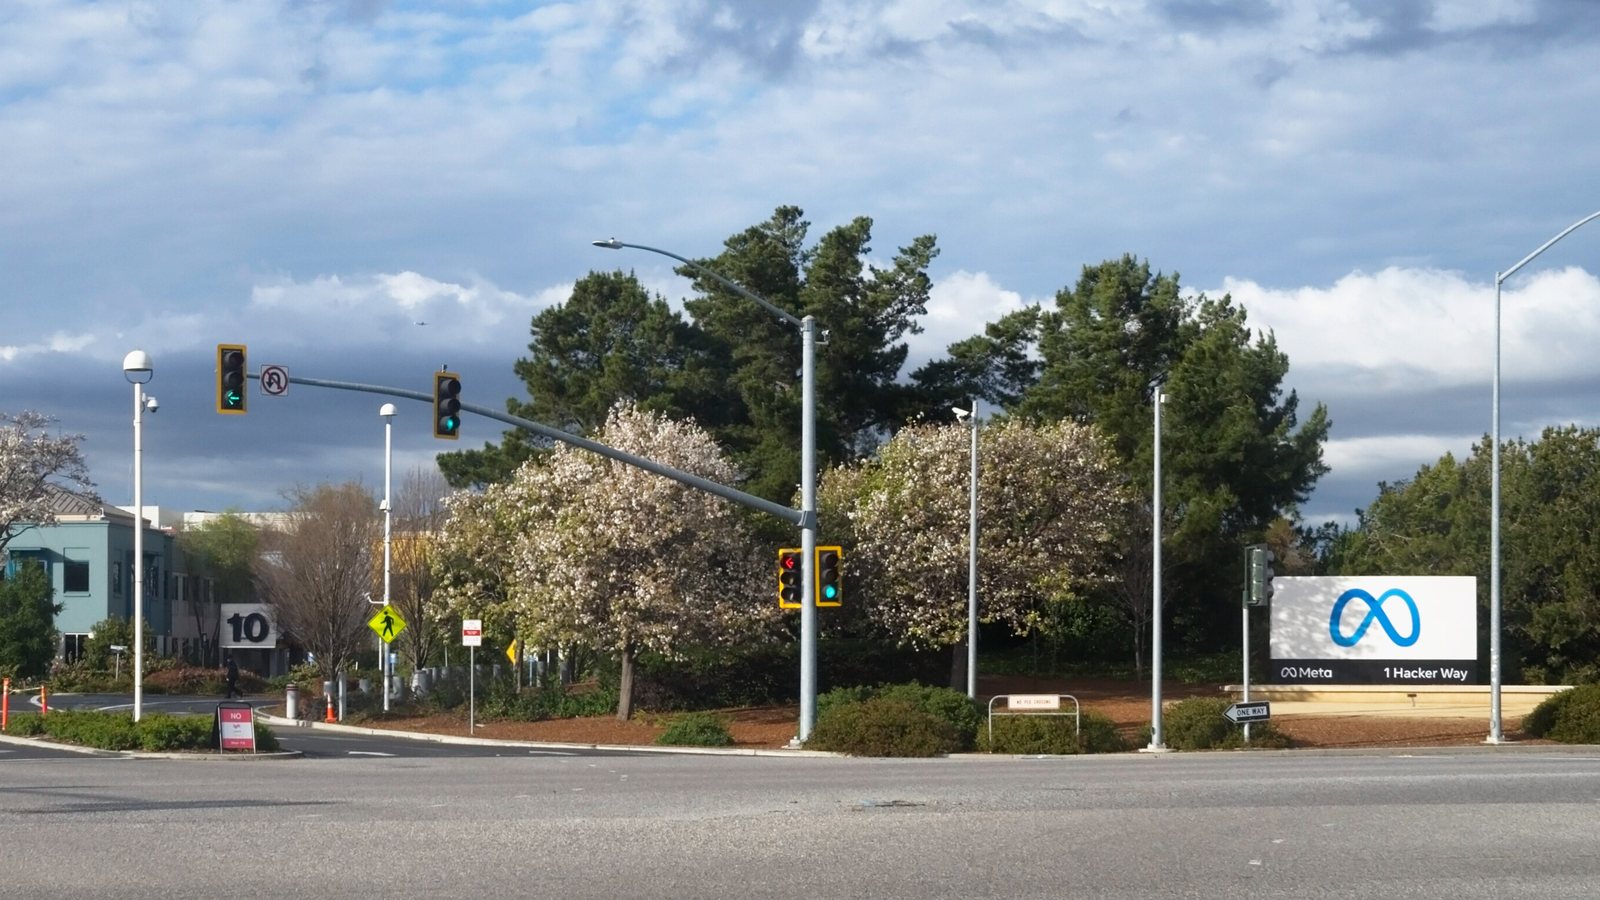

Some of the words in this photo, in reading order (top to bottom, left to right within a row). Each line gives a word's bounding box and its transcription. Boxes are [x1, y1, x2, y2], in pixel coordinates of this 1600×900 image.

[227, 613, 269, 643] 10
[1299, 667, 1333, 678] Meta
[1383, 667, 1390, 678] 1
[1393, 667, 1438, 679] Hacker
[1440, 667, 1468, 681] Way
[230, 712, 242, 720] NO
[1236, 709, 1251, 717] ONE
[1251, 707, 1266, 715] WAY
